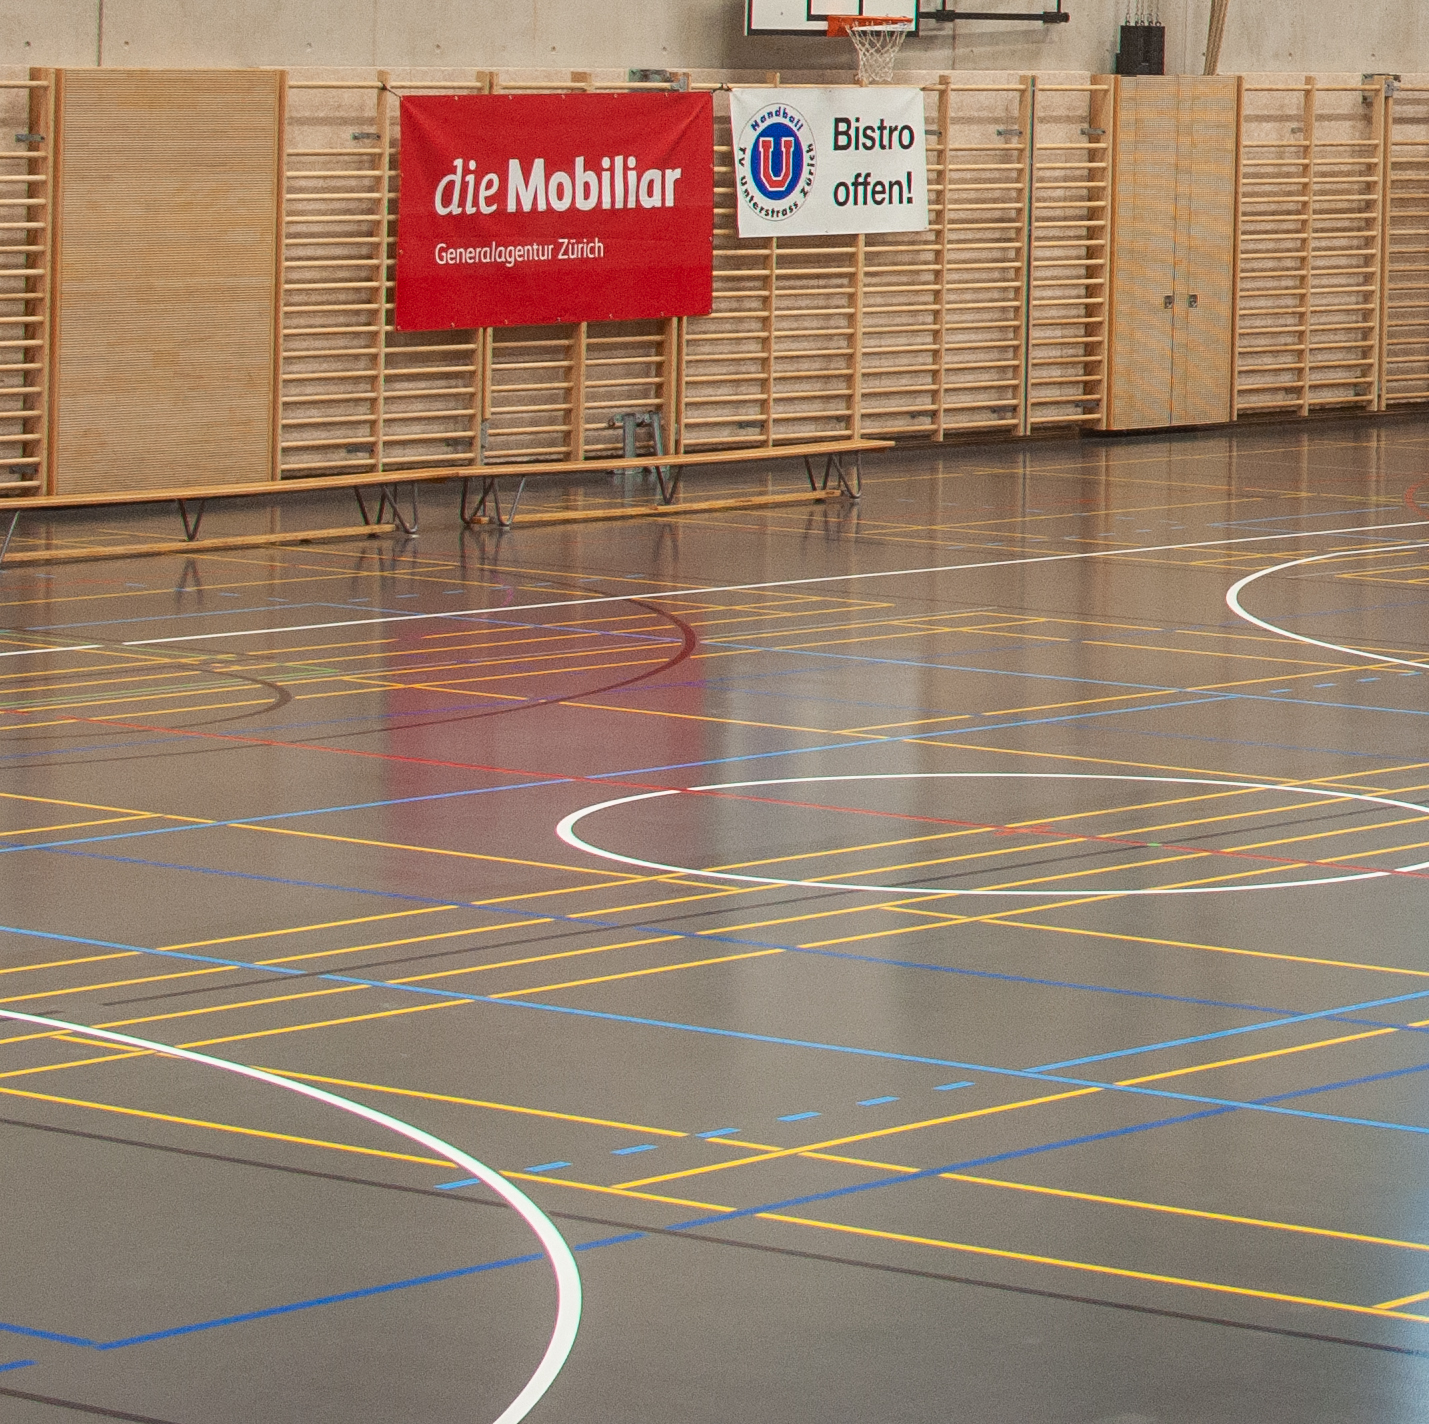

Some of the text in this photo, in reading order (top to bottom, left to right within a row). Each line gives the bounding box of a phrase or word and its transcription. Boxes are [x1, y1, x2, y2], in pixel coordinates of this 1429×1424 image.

[750, 106, 804, 132] Handball
[833, 117, 915, 151] Bistro
[738, 143, 815, 218] TV Unterstrass Zürich
[759, 137, 794, 191] U
[435, 155, 682, 215] die Mobiliar
[833, 171, 914, 207] offen!
[435, 238, 604, 267] Generalagentur Zürich
